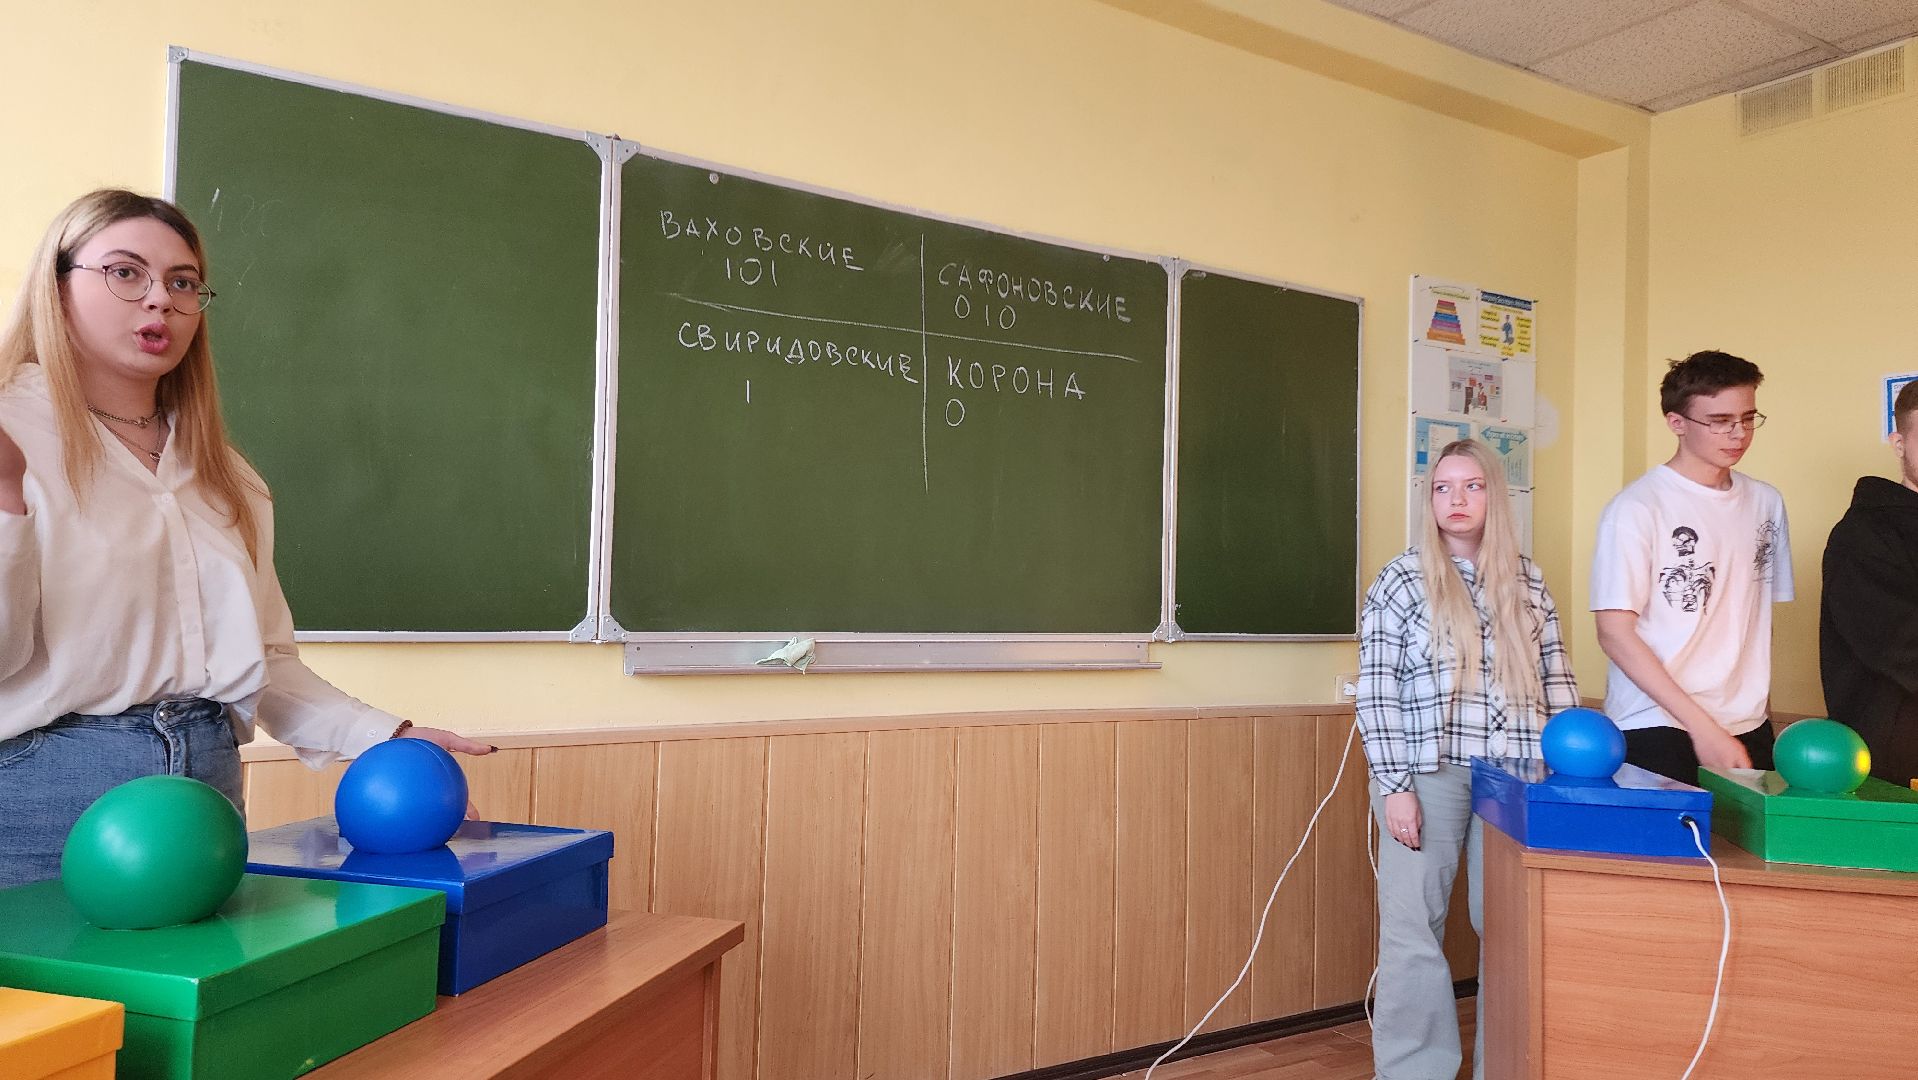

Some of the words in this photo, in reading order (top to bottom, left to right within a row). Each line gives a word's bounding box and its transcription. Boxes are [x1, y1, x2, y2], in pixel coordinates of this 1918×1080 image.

[659, 210, 864, 272] ВАХОВСКИЕ
[938, 262, 1131, 324] САФОНОВСКИЕ
[678, 321, 919, 383] СВИРИДОВСКИЕ
[947, 355, 1087, 400] КОРОНА
